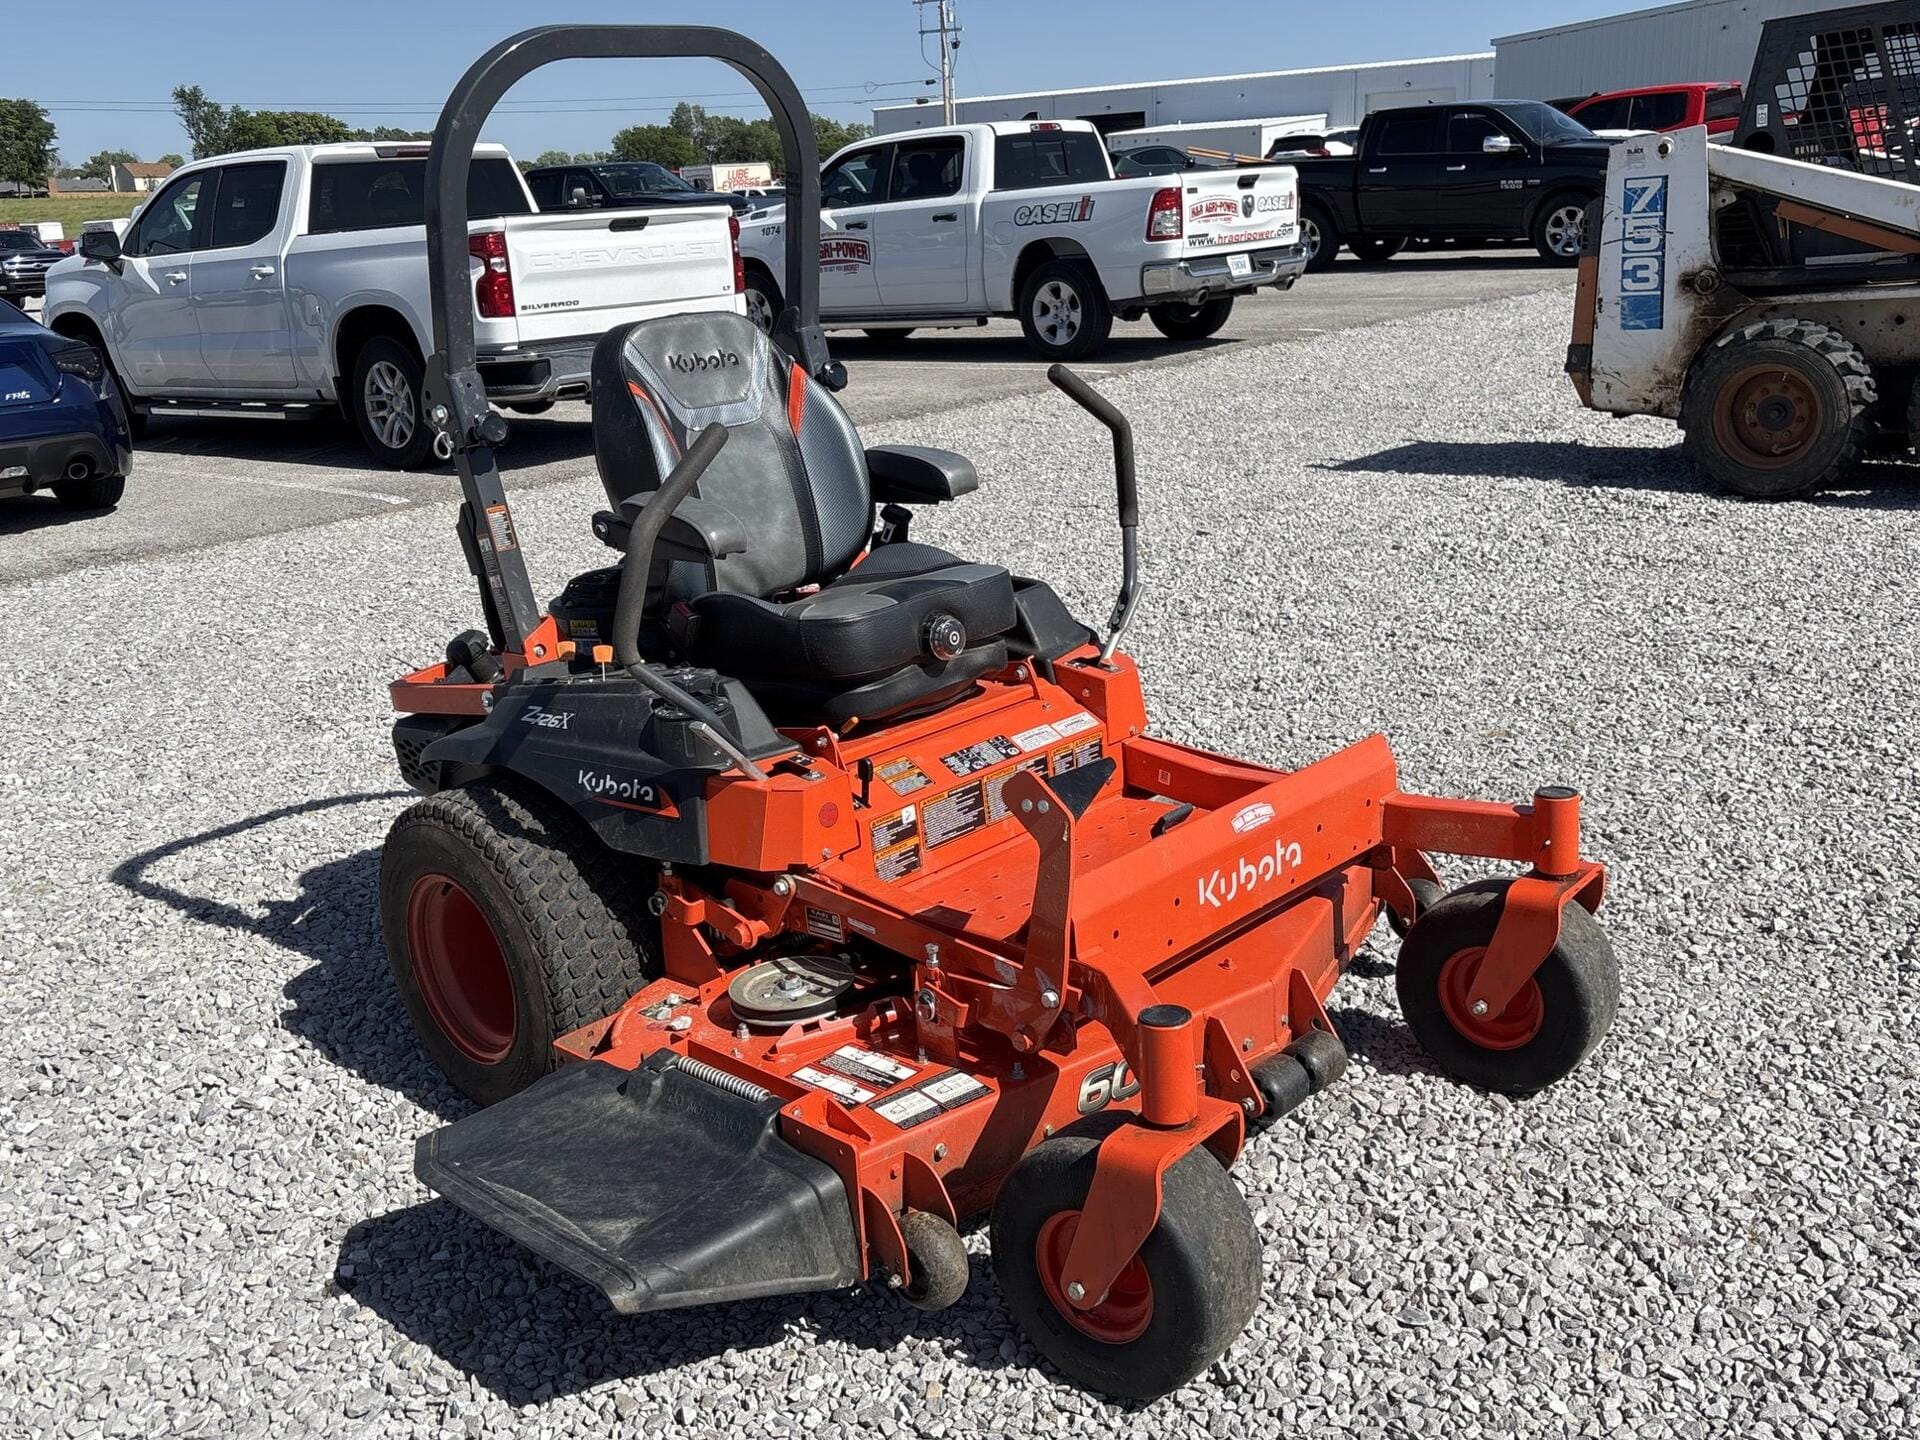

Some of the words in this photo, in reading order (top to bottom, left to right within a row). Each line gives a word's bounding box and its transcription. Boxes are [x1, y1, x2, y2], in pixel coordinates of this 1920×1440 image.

[727, 168, 750, 180] LUBE
[1014, 202, 1074, 226] CASE
[761, 226, 780, 236] 1074
[1188, 227, 1294, 247] www.hragripower.com
[530, 241, 721, 268] CHEVROLET
[820, 241, 869, 261] GRI-POWER
[521, 300, 579, 310] SILVERADO
[668, 349, 739, 373] Kubota
[578, 769, 654, 801] Kubota
[1198, 838, 1302, 908] Kubota
